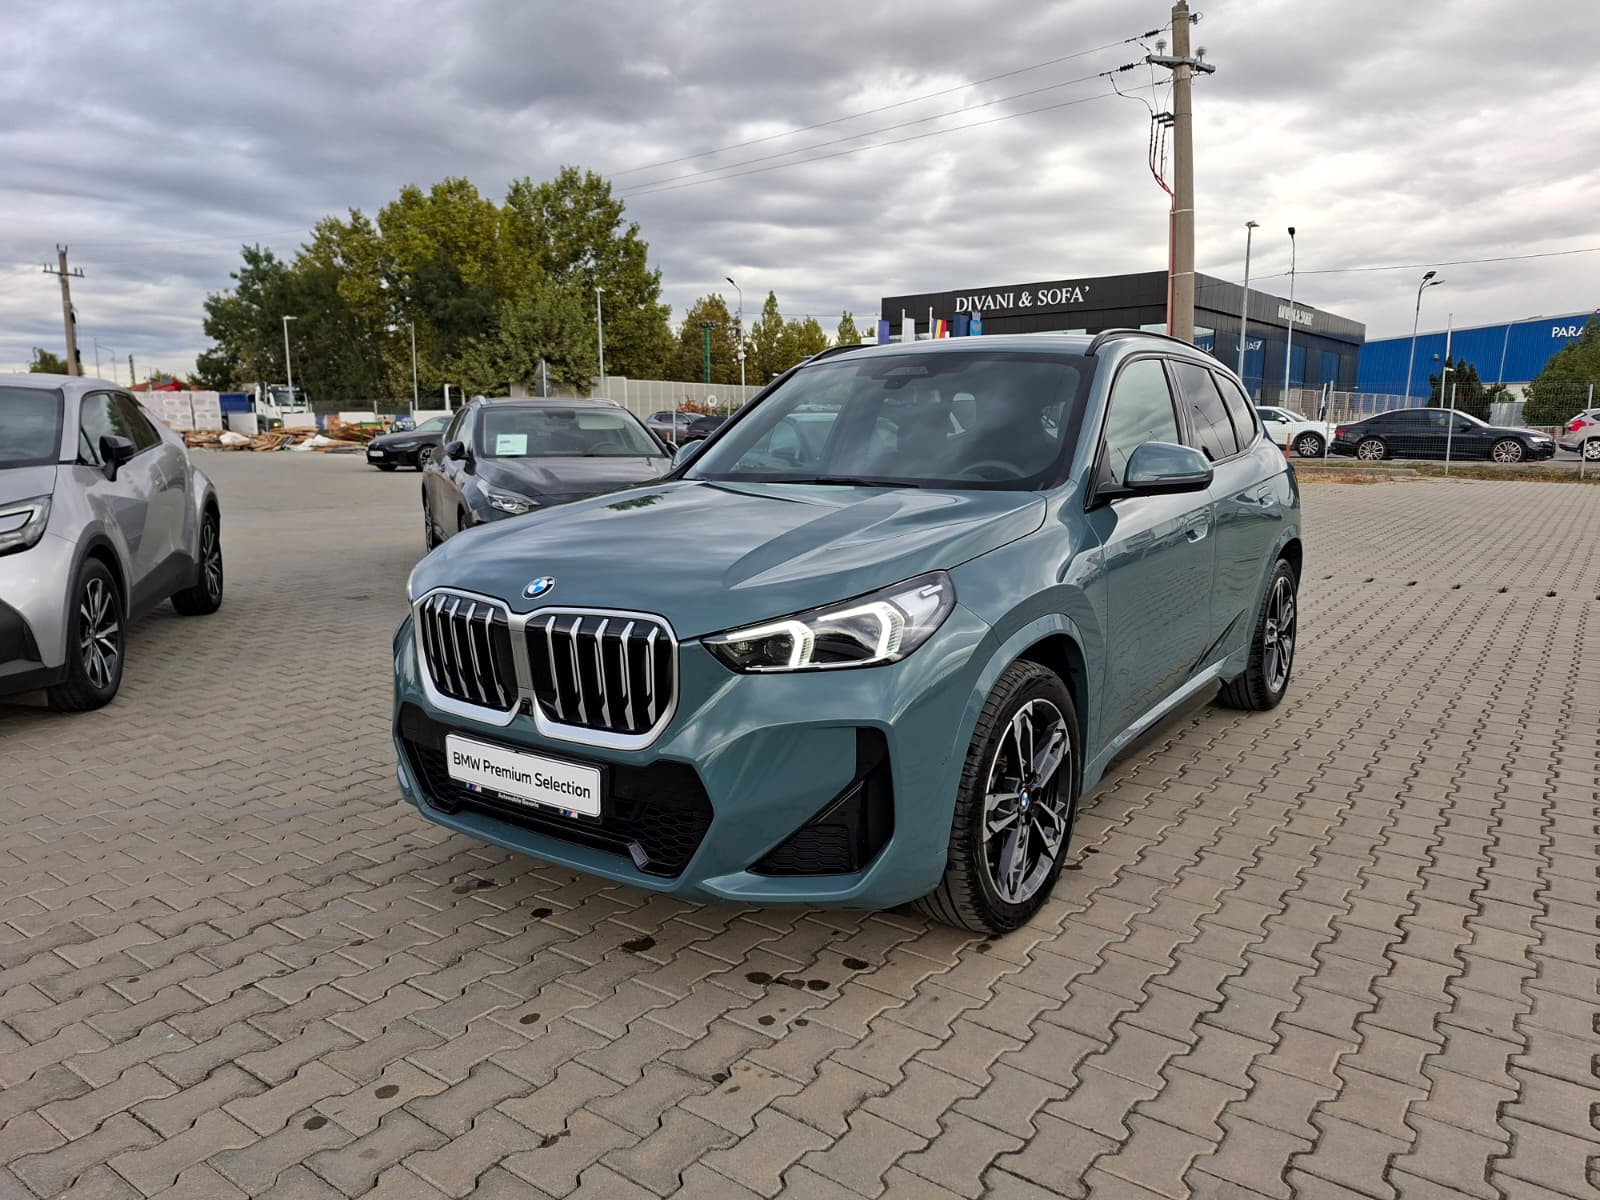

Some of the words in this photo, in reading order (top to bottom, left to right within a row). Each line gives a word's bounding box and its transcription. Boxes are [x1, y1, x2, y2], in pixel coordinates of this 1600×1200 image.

[955, 292, 1014, 313] DIVANI
[1018, 291, 1033, 308] &
[453, 751, 481, 771] BMW
[483, 759, 532, 785] Premium
[534, 772, 591, 799] Selection
